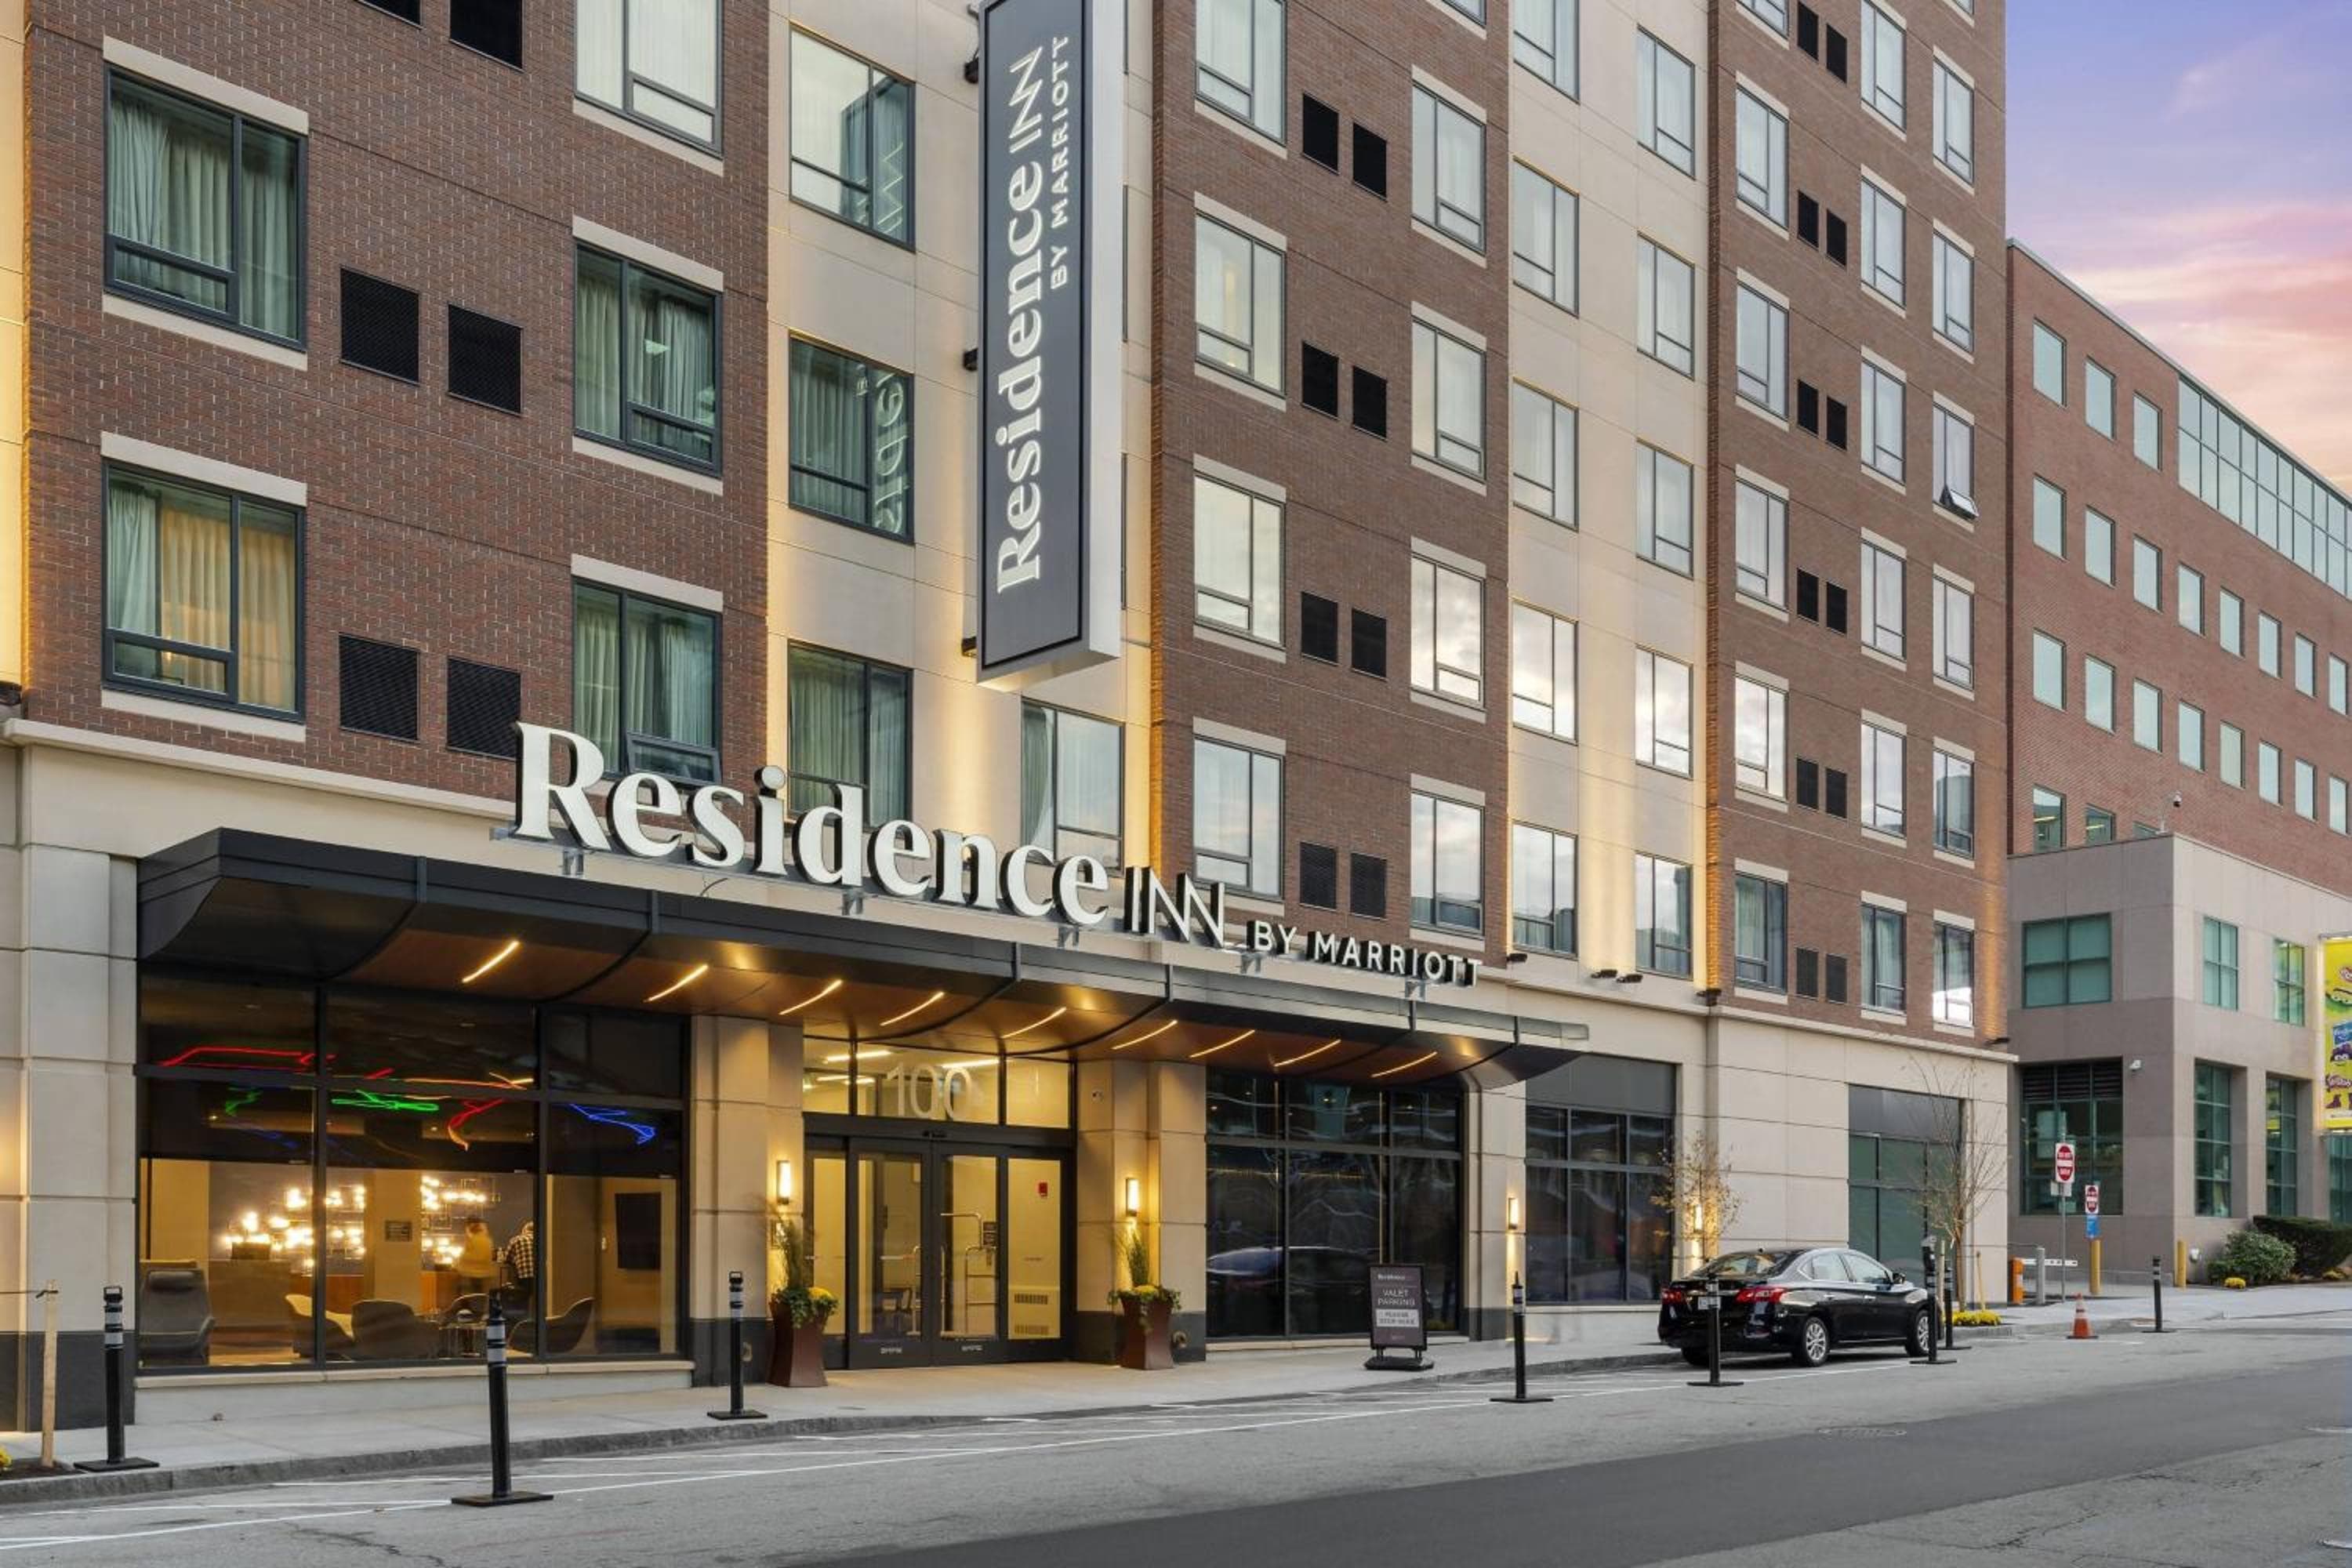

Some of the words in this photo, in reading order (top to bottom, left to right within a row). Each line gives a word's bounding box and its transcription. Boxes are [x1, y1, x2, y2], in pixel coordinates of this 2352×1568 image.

[1008, 45, 1044, 154] INN
[1051, 36, 1069, 229] MARRIOTT
[1051, 245, 1069, 290] BY
[996, 160, 1044, 594] Residence
[513, 720, 1109, 926] Residence
[1125, 866, 1225, 948] INN
[1252, 920, 1298, 954] BY
[1312, 929, 1483, 987] MARRIOTT
[887, 1062, 972, 1122] 100
